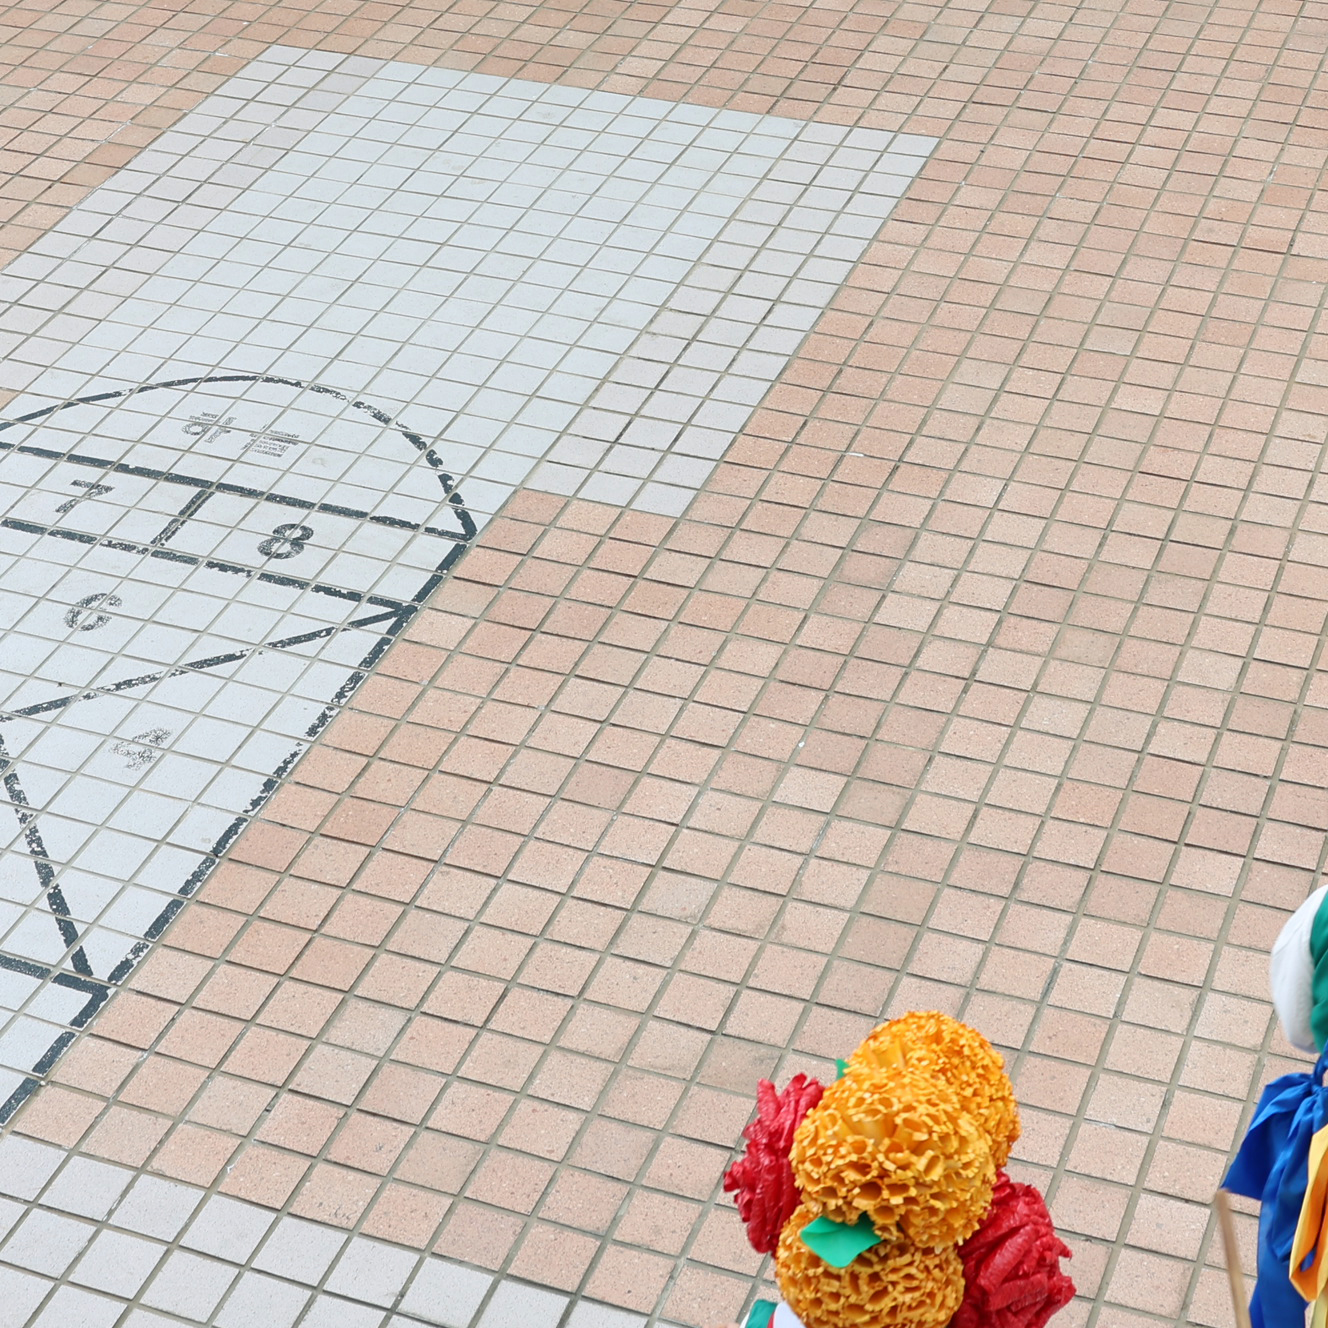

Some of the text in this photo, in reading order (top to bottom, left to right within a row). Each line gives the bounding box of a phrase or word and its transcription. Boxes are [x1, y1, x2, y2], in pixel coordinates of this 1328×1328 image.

[56, 479, 115, 519] 7
[257, 522, 314, 562] 8
[62, 592, 124, 633] 6
